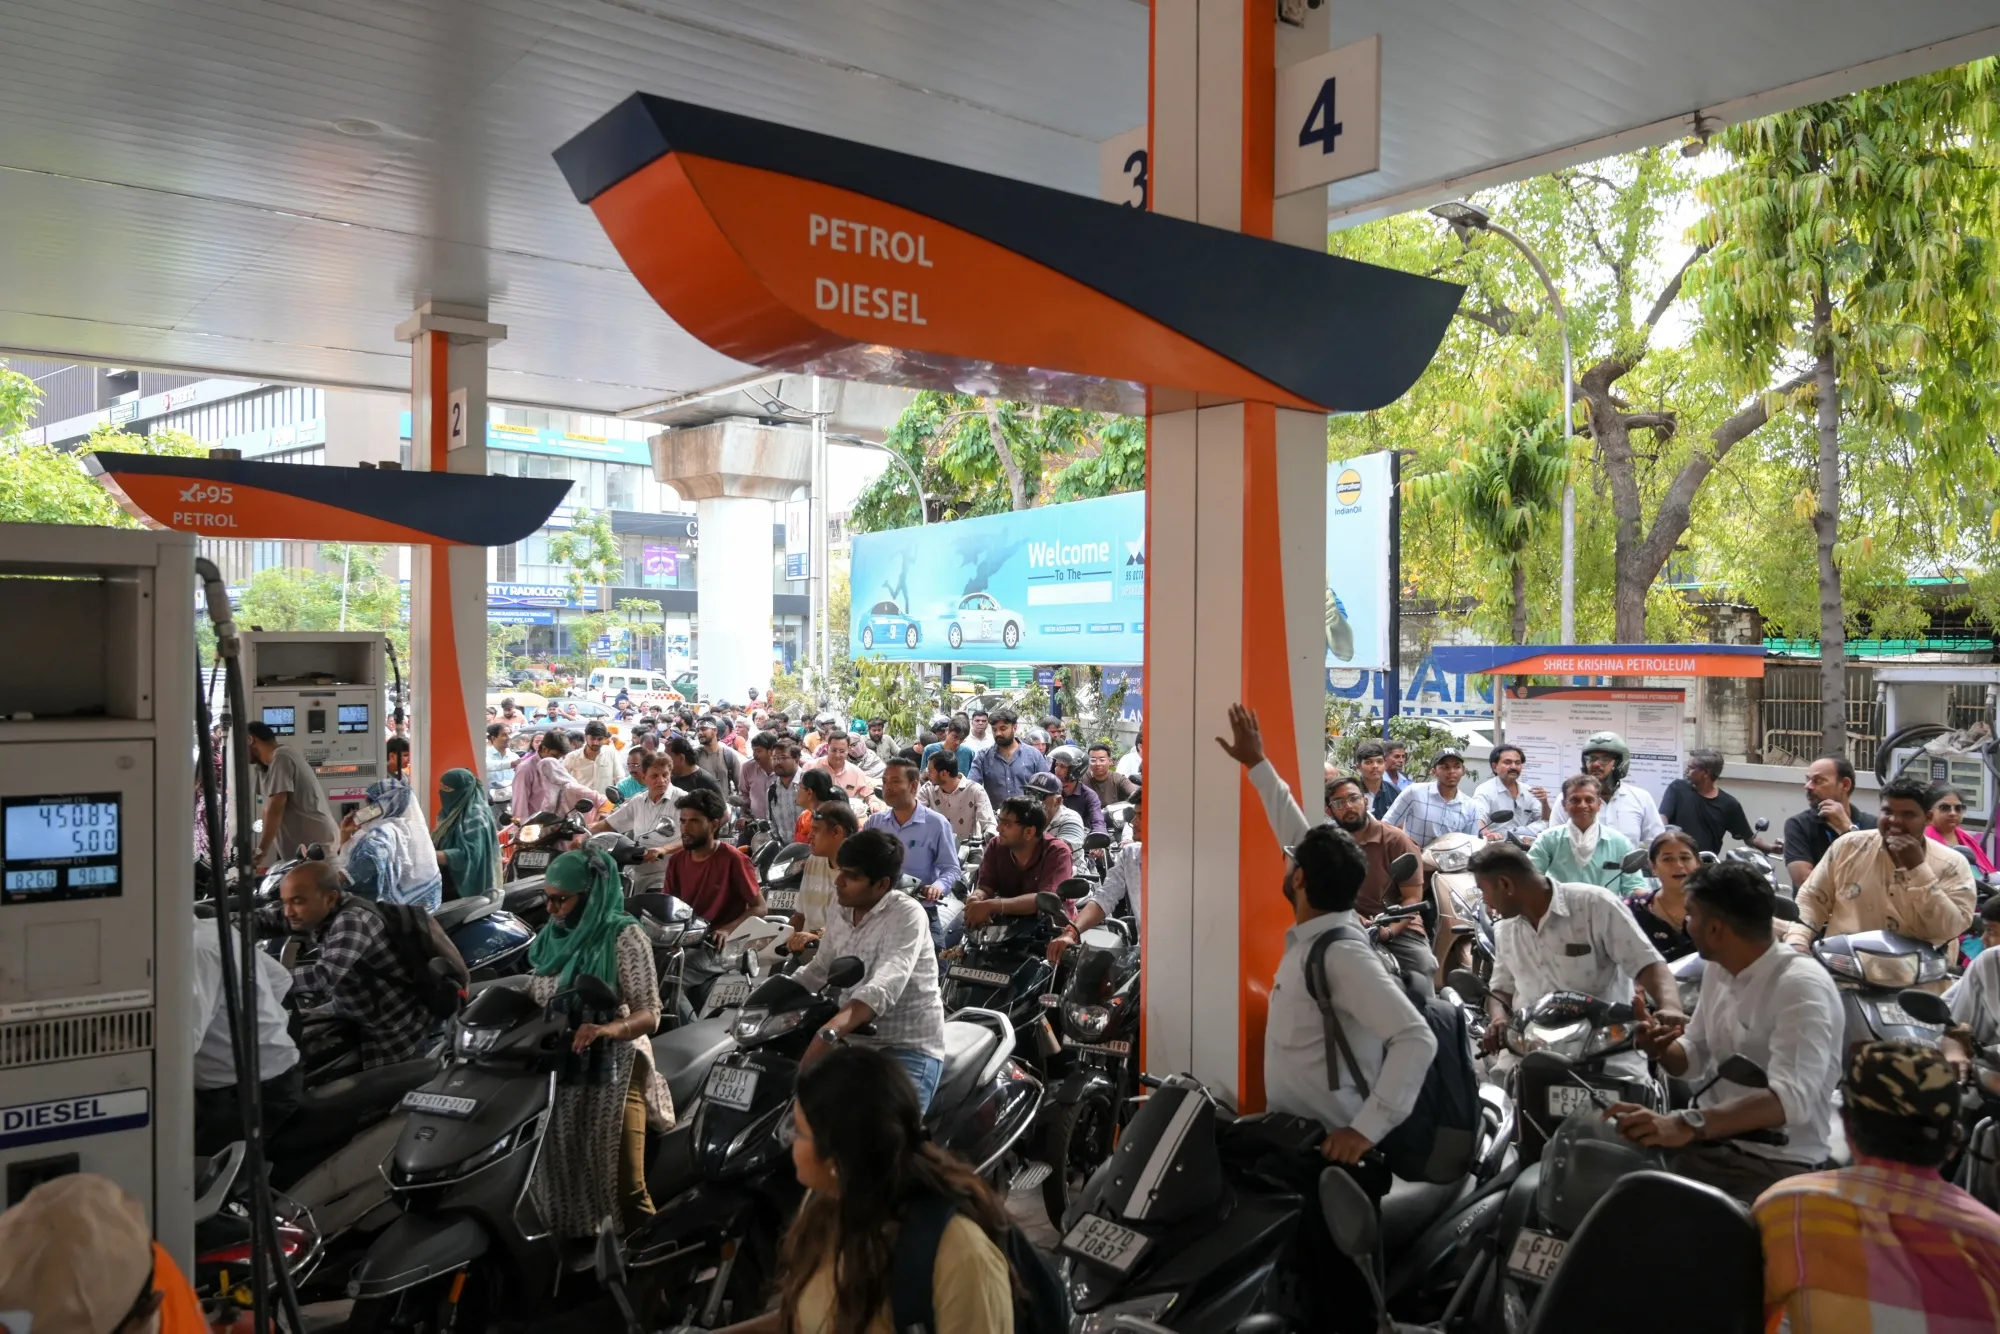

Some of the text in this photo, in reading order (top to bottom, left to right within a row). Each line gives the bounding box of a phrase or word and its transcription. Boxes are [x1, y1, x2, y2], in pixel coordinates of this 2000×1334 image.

[1298, 76, 1343, 155] 4
[1123, 149, 1148, 211] 3
[809, 213, 933, 268] PETROL
[816, 277, 928, 325] DIESEL
[452, 402, 461, 437] 2
[179, 483, 234, 505] XP95
[173, 512, 238, 527] PETROL
[1335, 506, 1362, 516] IndianOil
[1028, 540, 1110, 568] Welcome
[1055, 569, 1081, 580] To The
[510, 586, 568, 597] RADIOLOGY
[981, 620, 992, 639] 95
[1544, 658, 1695, 671] SHREE KRISHNA PETROLEUM
[40, 804, 115, 828] 450.85
[72, 829, 115, 853] 5.00
[772, 900, 794, 909] G7502
[724, 985, 746, 995] GJ01
[4, 1099, 107, 1131] DIESEL
[1077, 1234, 1124, 1261] T0837
